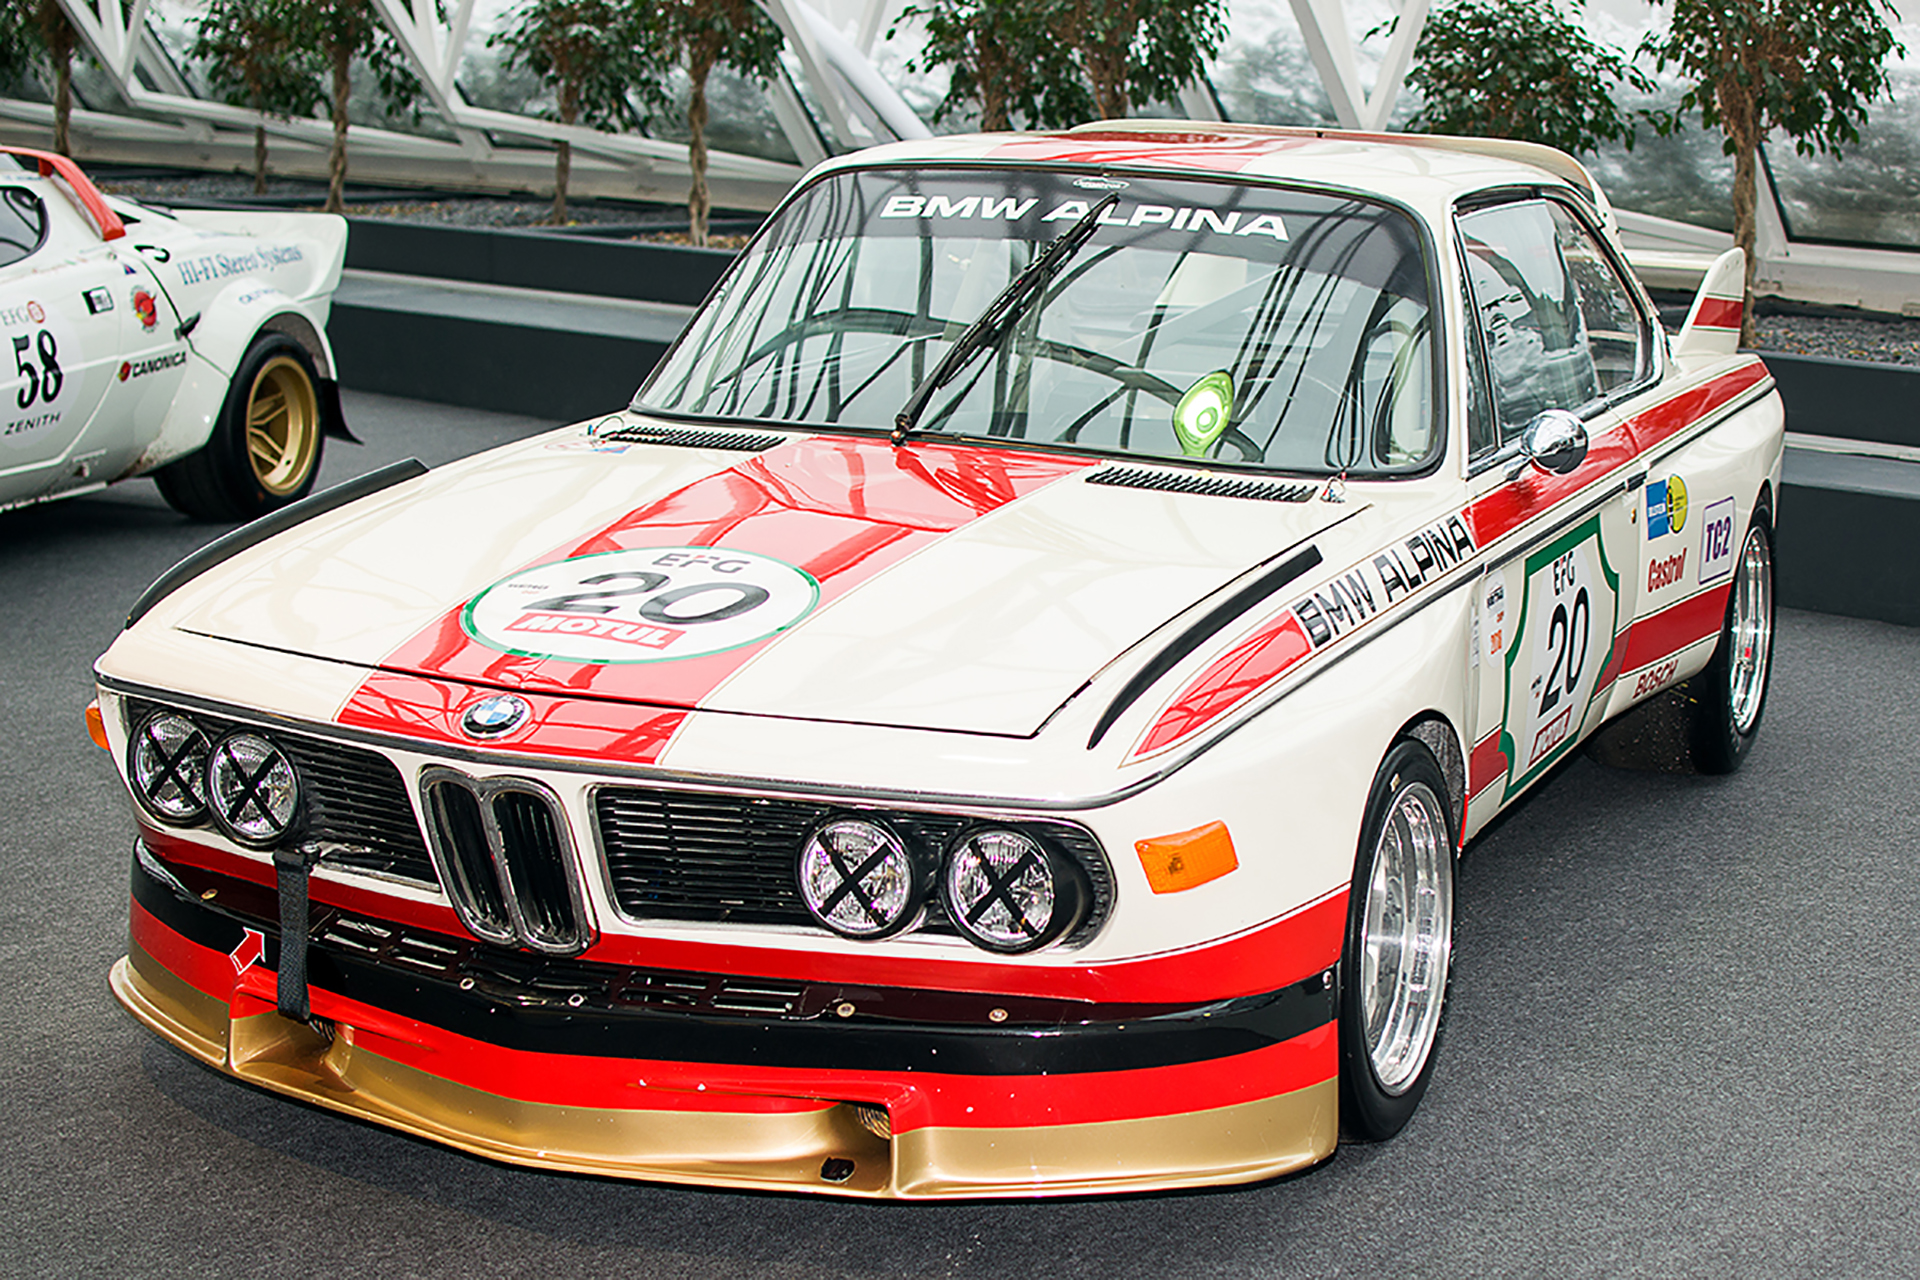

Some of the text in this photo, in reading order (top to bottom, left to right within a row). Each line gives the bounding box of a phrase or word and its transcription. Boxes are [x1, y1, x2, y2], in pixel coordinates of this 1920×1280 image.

[880, 195, 1290, 242] BMW ALPINA
[177, 257, 219, 286] HI-FI
[216, 252, 259, 277] Stereo
[1, 305, 29, 326] EFG
[12, 329, 64, 409] 58
[132, 351, 187, 378] CANONICA
[4, 411, 62, 436] ZENITH
[1704, 516, 1731, 563] TC2
[652, 552, 751, 574] EFG
[1292, 568, 1377, 648] BMW
[1373, 515, 1476, 603] ALPINA
[1553, 551, 1576, 596] EFG
[1647, 547, 1688, 593] Castrol
[521, 571, 770, 624] 20
[510, 614, 668, 647] MOTUL
[1537, 586, 1589, 719] 20
[1632, 659, 1679, 699] BOSCH
